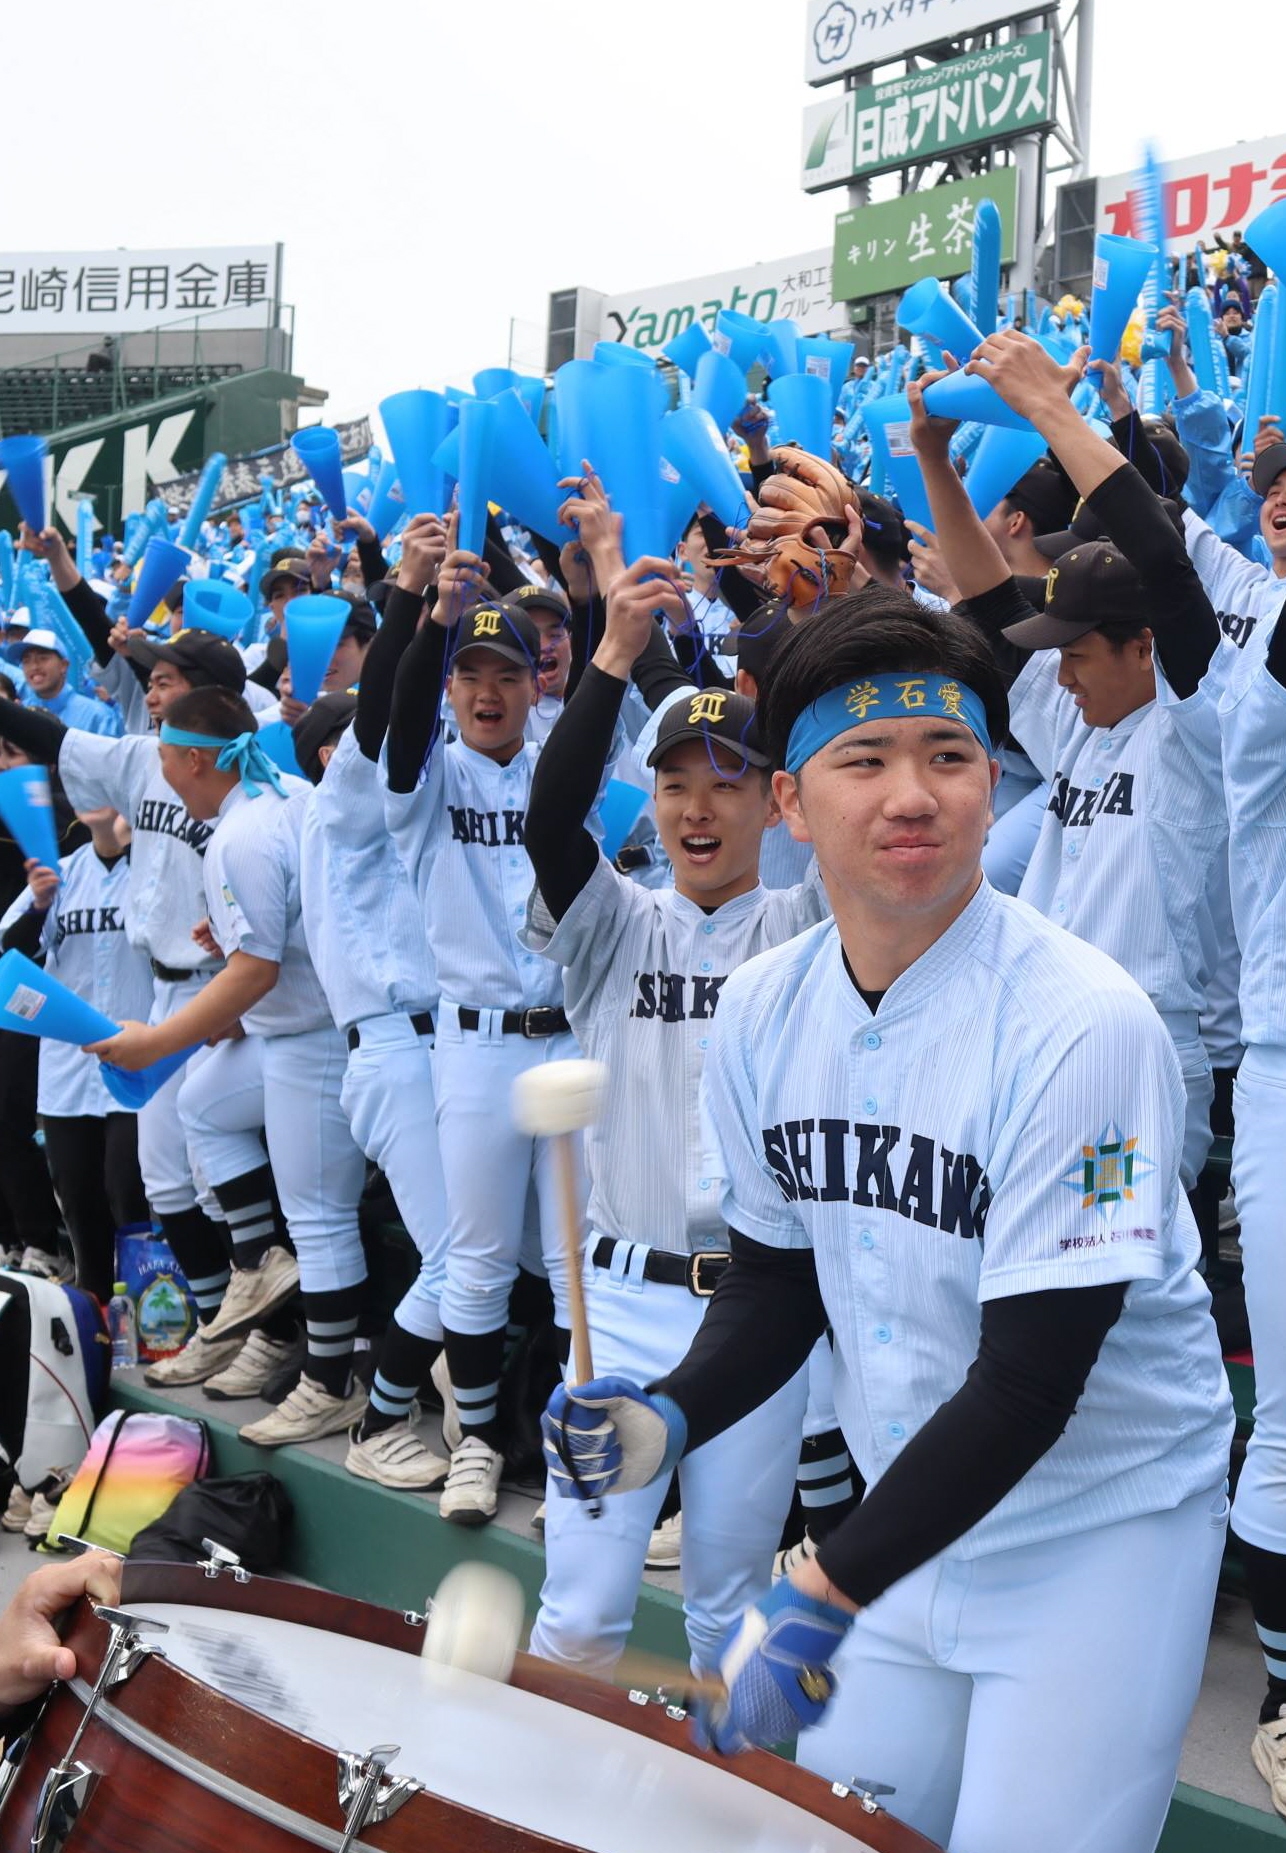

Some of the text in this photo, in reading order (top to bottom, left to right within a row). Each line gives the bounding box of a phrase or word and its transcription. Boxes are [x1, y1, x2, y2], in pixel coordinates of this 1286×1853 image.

[855, 58, 1046, 168] 日成アドバンス
[905, 198, 975, 263] 生茶
[0, 260, 268, 314] 尼崎信用金庫
[781, 266, 833, 294] 大和工
